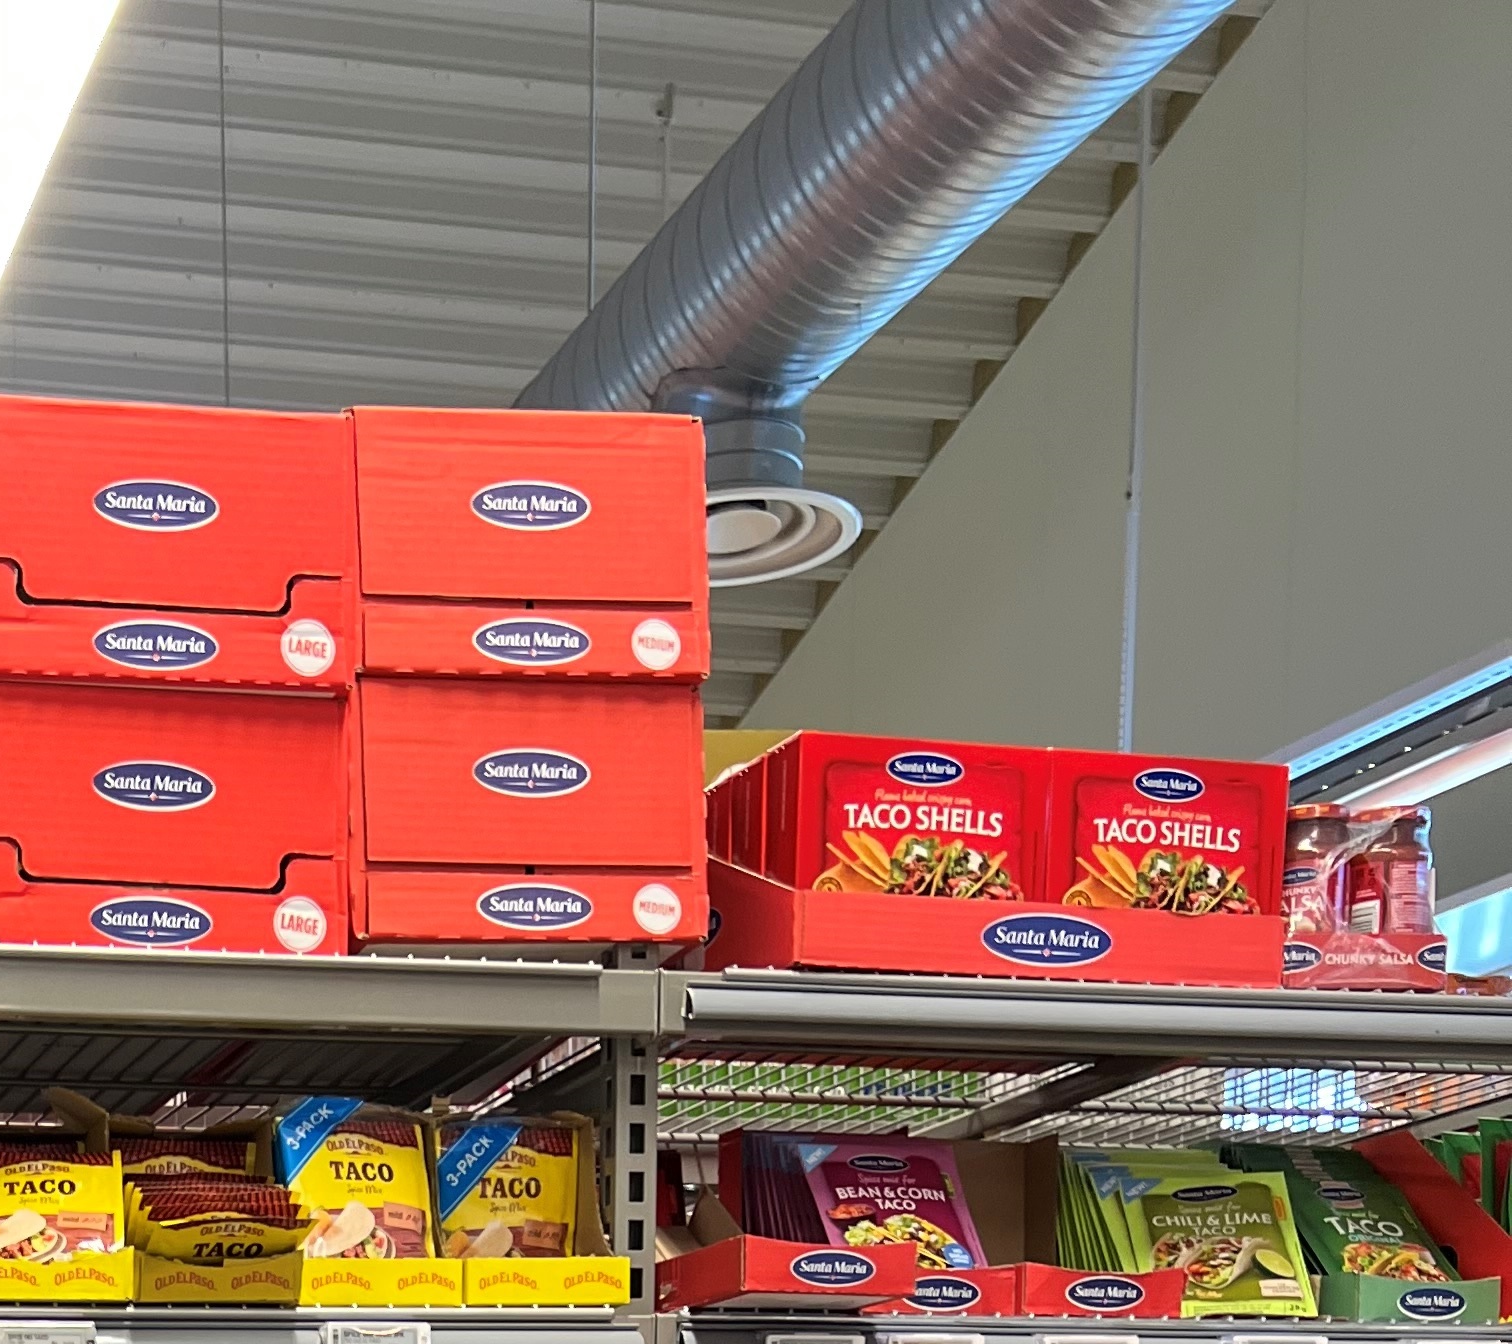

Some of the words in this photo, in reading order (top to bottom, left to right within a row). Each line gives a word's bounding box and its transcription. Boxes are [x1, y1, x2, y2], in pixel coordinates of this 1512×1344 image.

[844, 804, 911, 829] TACO
[916, 807, 1003, 838] SHELLS
[1094, 819, 1155, 844] TACO
[1160, 820, 1240, 853] SHELLS
[1325, 953, 1374, 965] CHUNKY
[1379, 953, 1414, 965] SALSA
[446, 1135, 494, 1187] 3-PACK
[330, 1161, 394, 1182] TACO
[3, 1180, 76, 1196] TACO
[836, 1187, 881, 1200] BEAN
[883, 1188, 896, 1200] &
[898, 1189, 945, 1203] CORN
[875, 1198, 917, 1211] TACO
[1152, 1215, 1202, 1227] CHILI
[1206, 1214, 1220, 1226] &
[1224, 1213, 1271, 1225] LIME
[1193, 1226, 1236, 1236] TACO
[193, 1242, 263, 1258] TACO
[799, 1260, 831, 1274] Santa
[834, 1261, 867, 1275] Maria
[915, 1286, 939, 1298] anta
[941, 1286, 972, 1299] Maria
[1073, 1286, 1105, 1298] Santa
[1107, 1287, 1137, 1300] Maria
[1405, 1294, 1430, 1308] Santa
[1432, 1295, 1461, 1308] Maria
